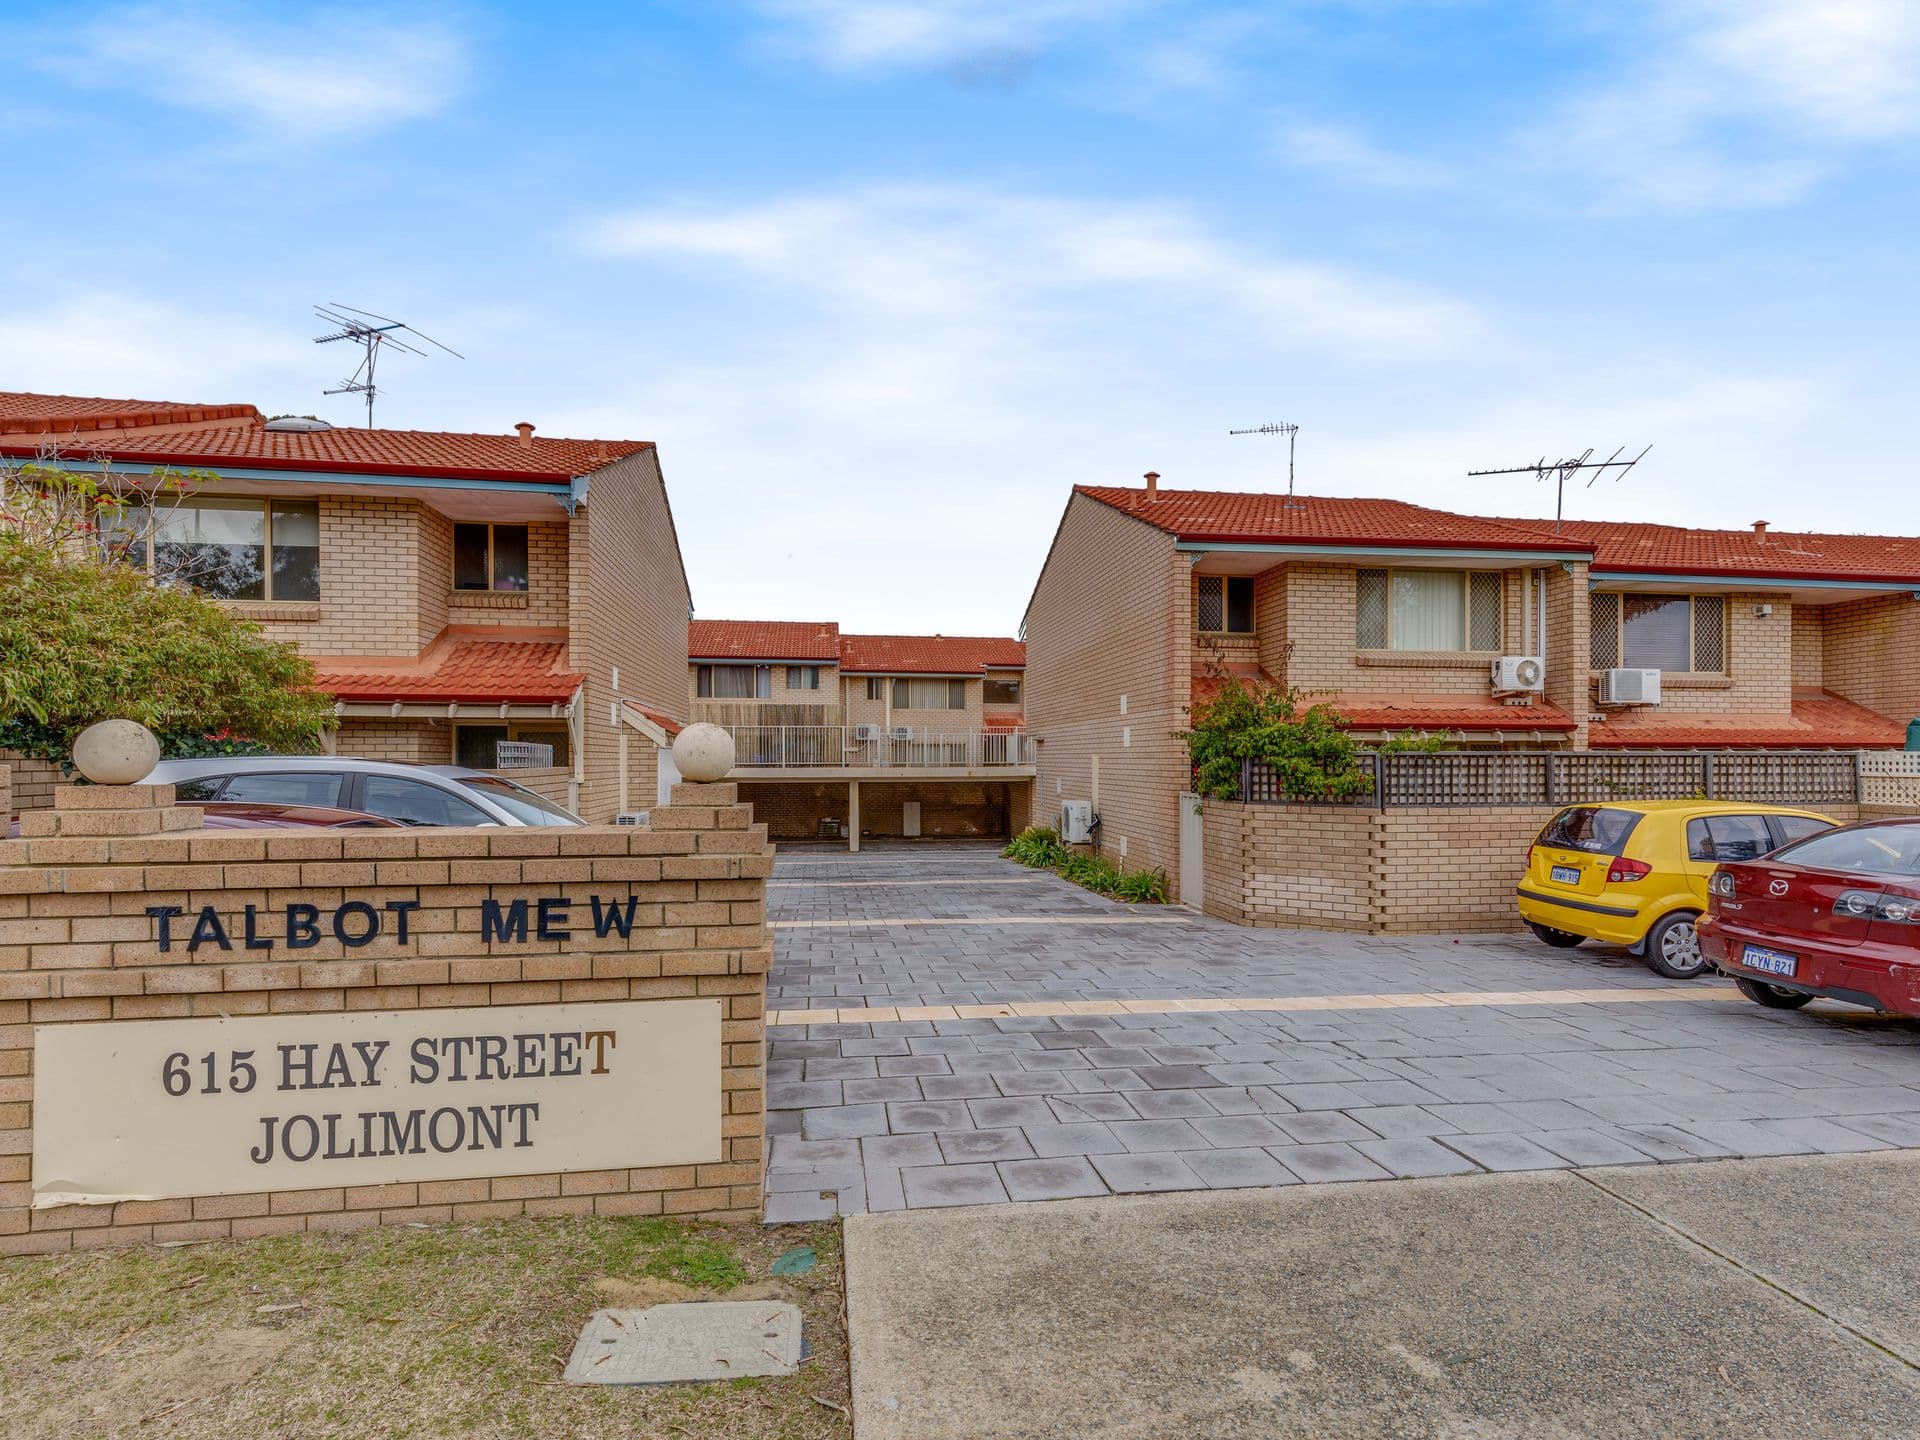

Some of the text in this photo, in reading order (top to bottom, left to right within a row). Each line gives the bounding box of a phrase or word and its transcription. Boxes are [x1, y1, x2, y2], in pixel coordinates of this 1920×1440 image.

[146, 895, 638, 952] TALBOT MEW
[163, 1031, 617, 1097] 615 HAY STREET
[250, 1103, 540, 1165] JOLIMONT
